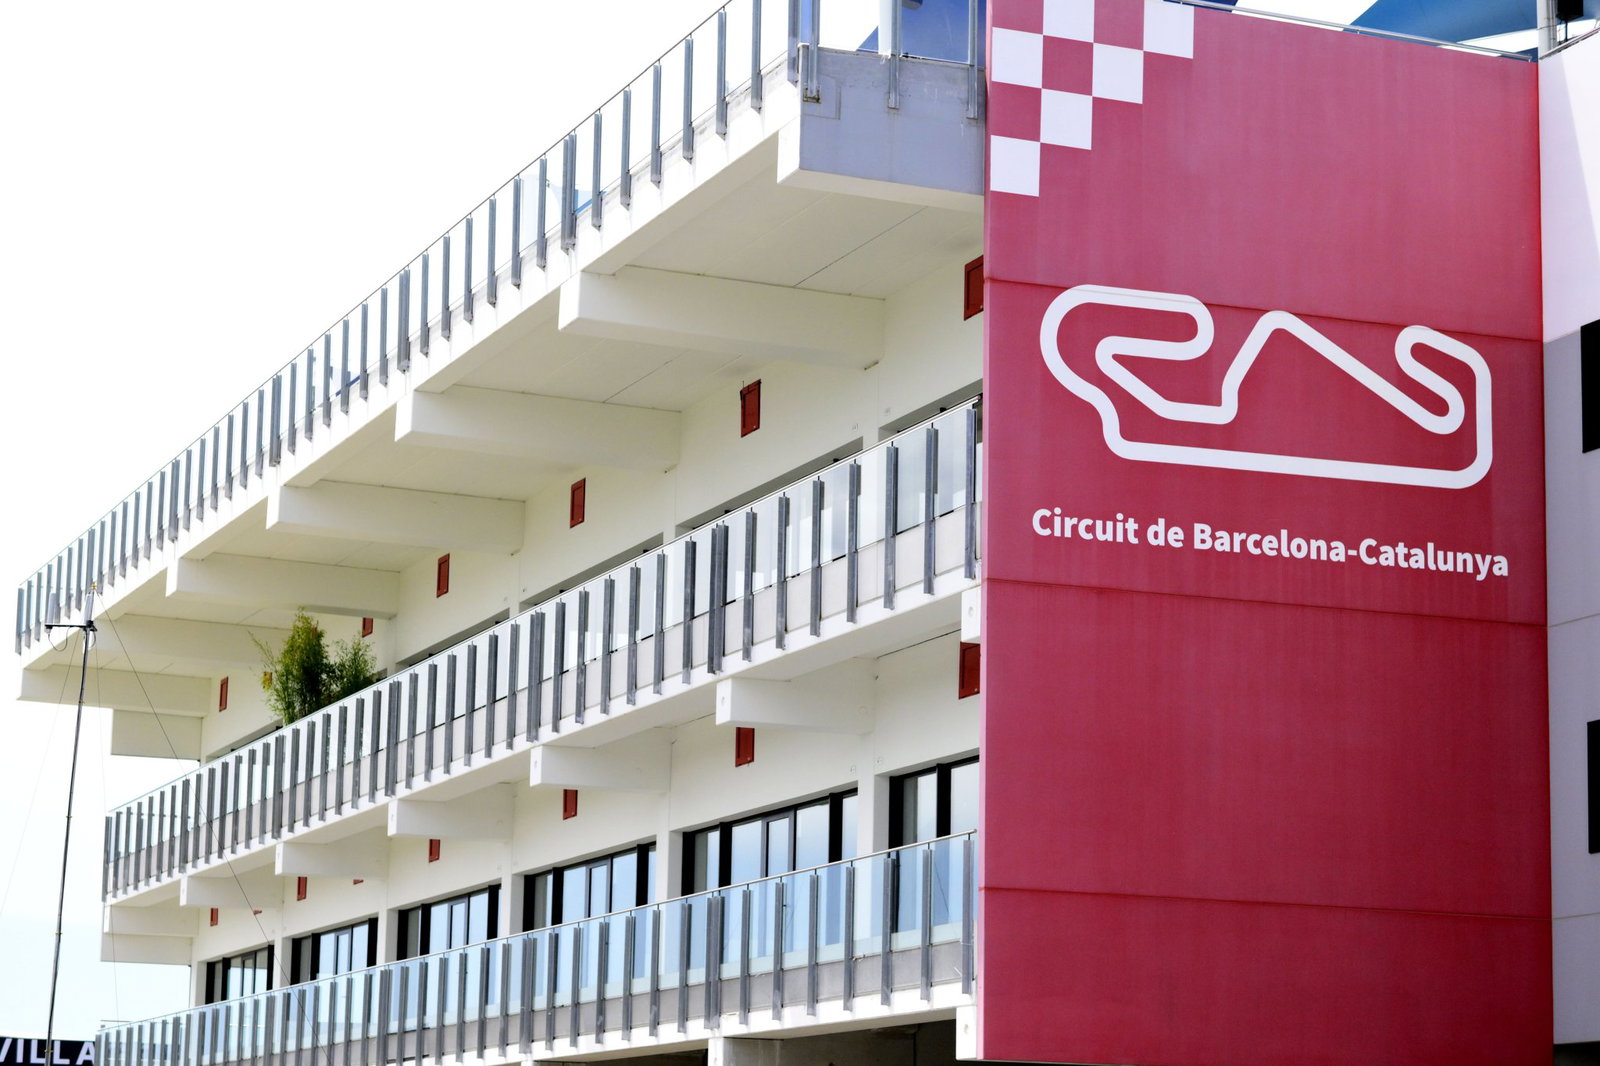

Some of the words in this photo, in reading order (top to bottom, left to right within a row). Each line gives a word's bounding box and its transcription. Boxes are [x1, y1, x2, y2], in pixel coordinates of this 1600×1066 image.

[1032, 507, 1139, 545] Circuit
[1146, 517, 1185, 548] de
[1193, 522, 1508, 581] Barcelona-Catalunya
